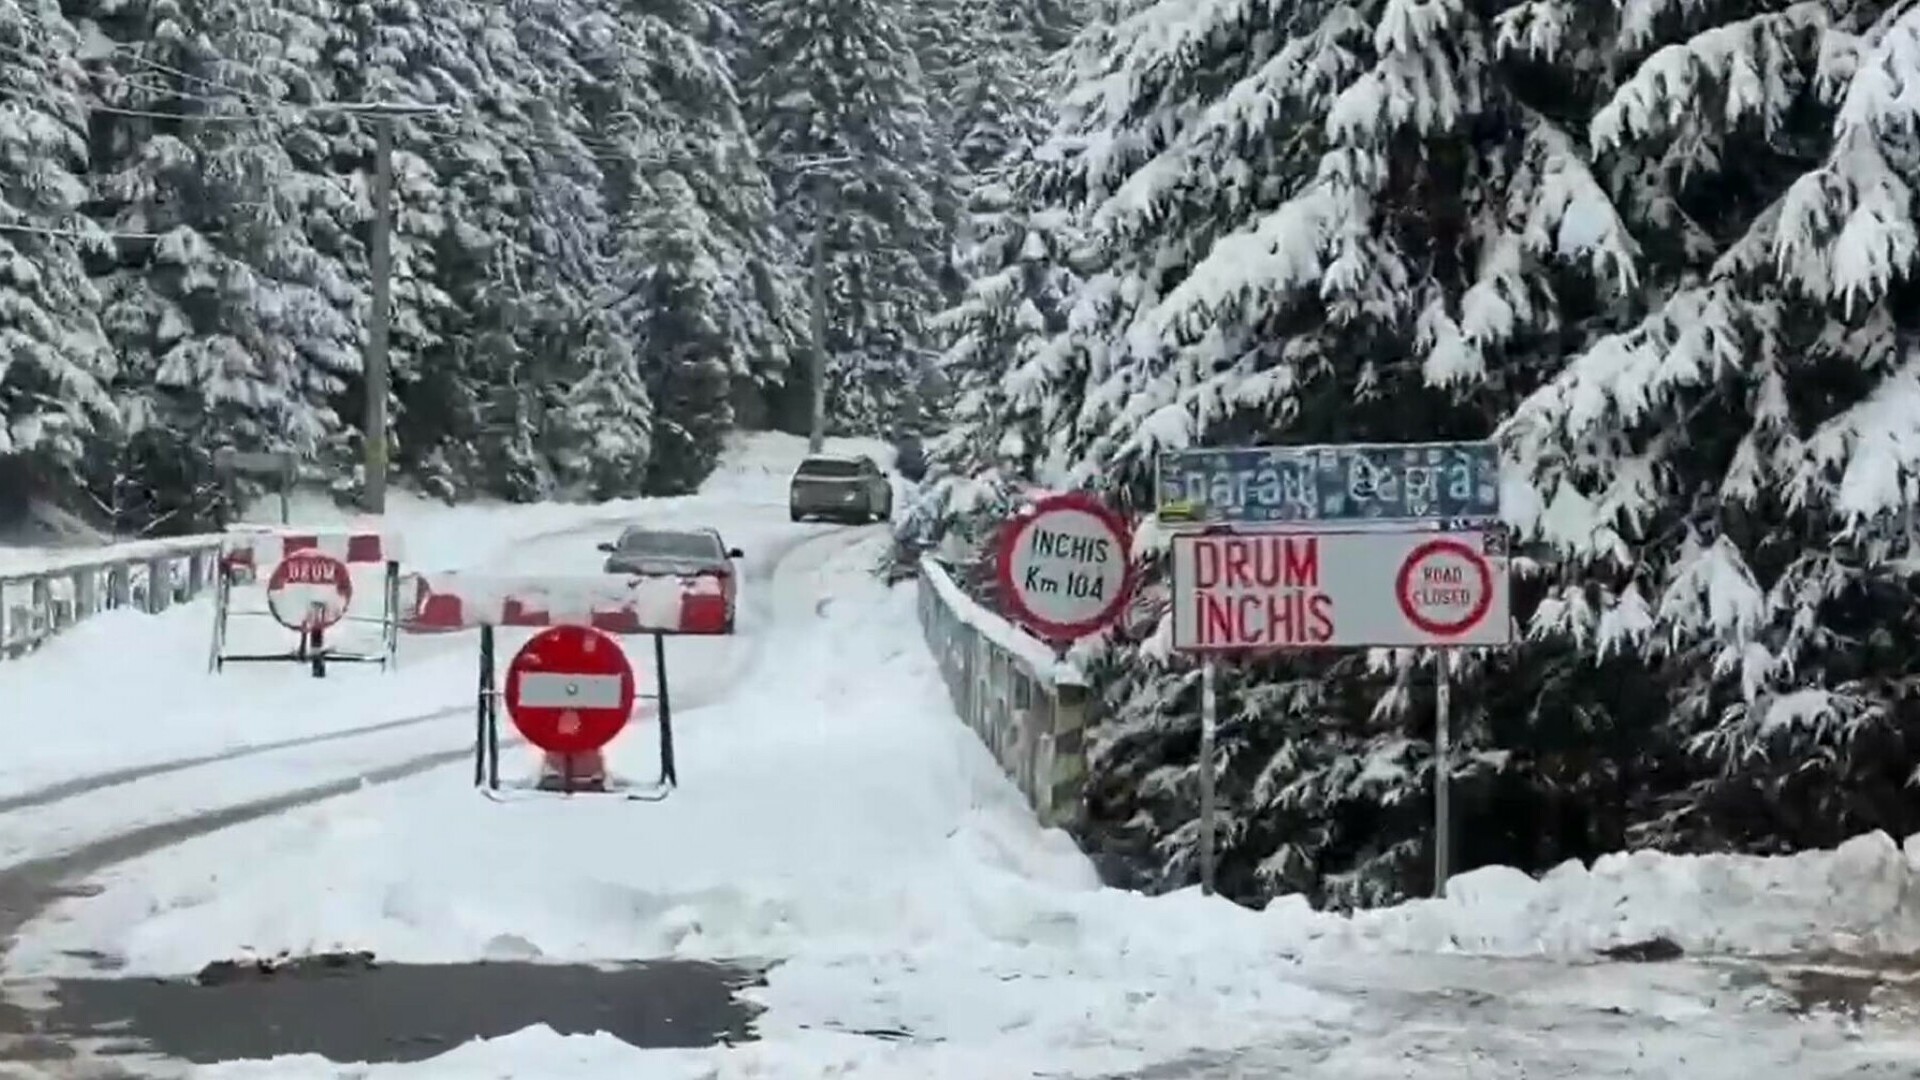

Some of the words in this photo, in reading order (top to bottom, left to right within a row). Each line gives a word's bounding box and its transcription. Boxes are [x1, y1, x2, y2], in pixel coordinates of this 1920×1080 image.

[1032, 527, 1109, 564] INCHIS
[285, 561, 336, 580] DRUM
[1194, 538, 1318, 588] DRUM
[1424, 567, 1463, 583] ROAD
[1025, 566, 1059, 594] Km
[1066, 571, 1104, 601] 104
[1413, 587, 1470, 606] CLOSED
